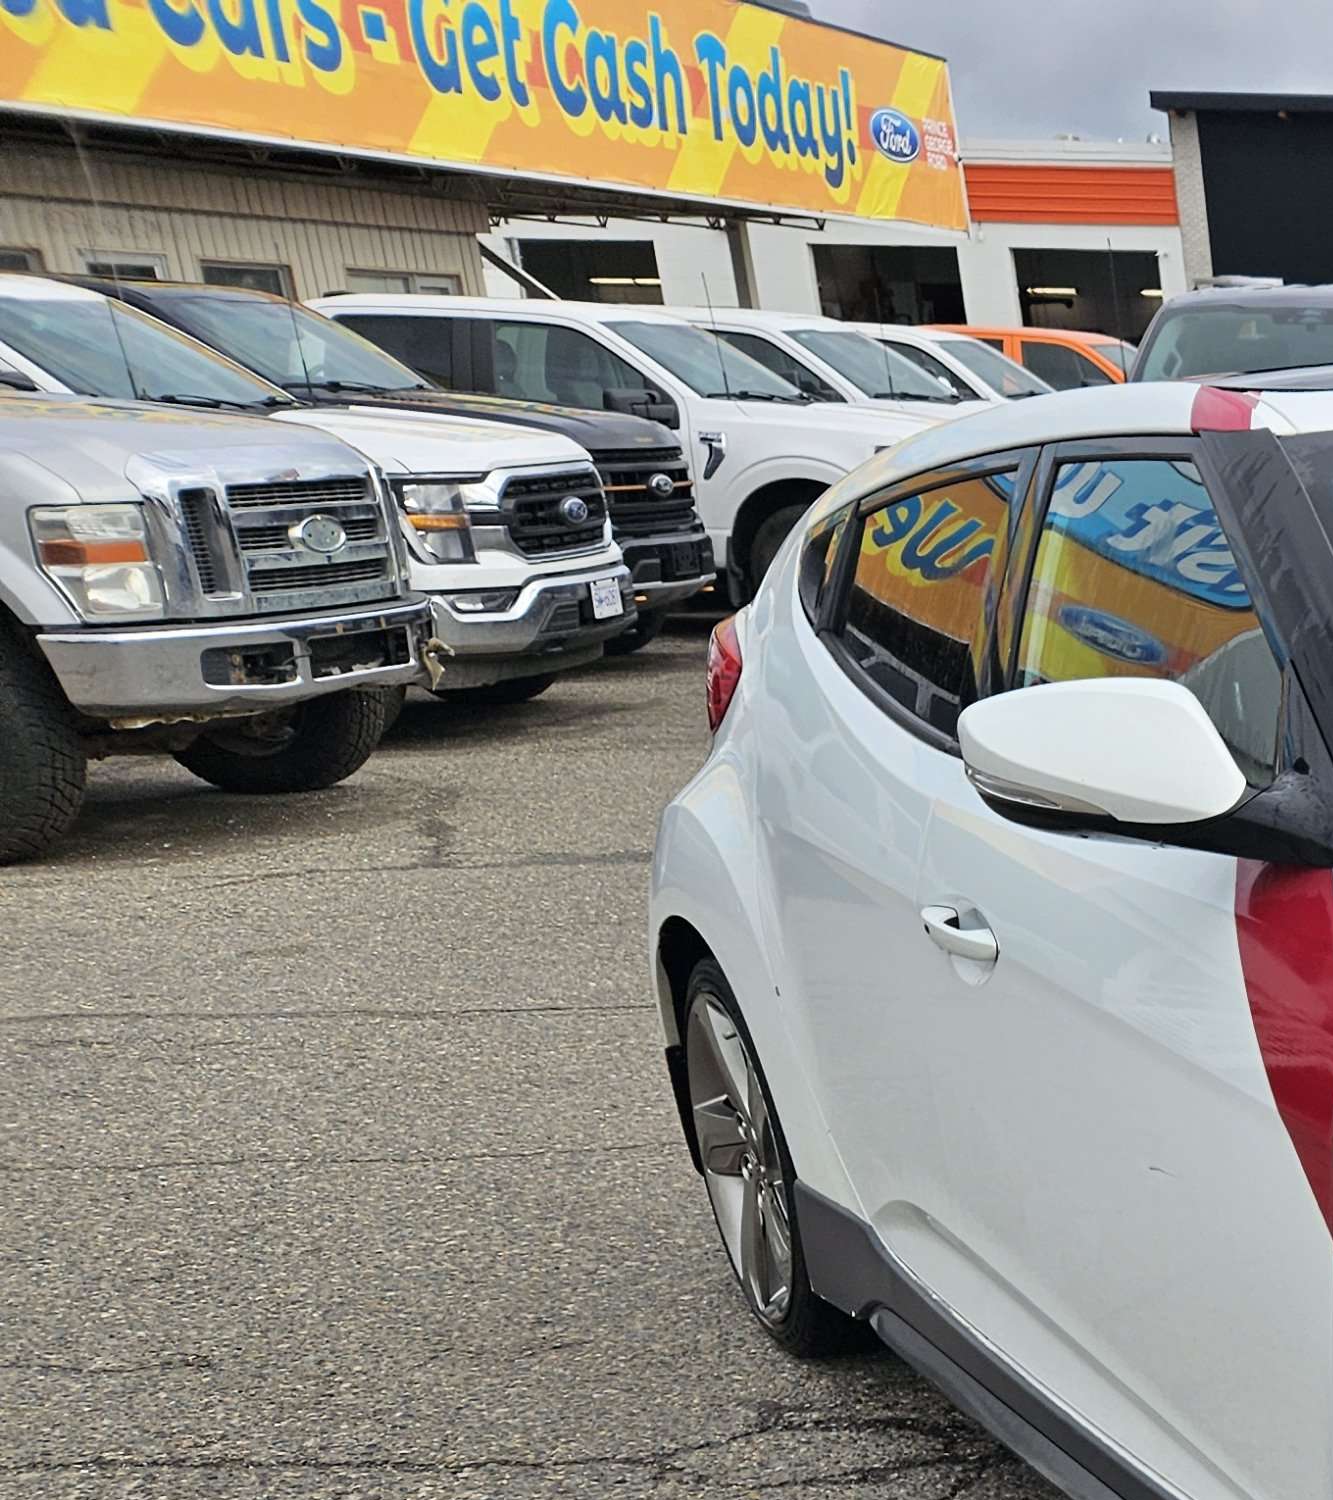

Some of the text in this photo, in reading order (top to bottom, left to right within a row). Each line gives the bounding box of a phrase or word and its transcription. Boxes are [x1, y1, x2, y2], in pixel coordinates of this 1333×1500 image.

[409, 0, 530, 107] Get
[543, 0, 687, 135] Cash
[695, 33, 856, 188] Today!
[878, 112, 914, 157] Ford
